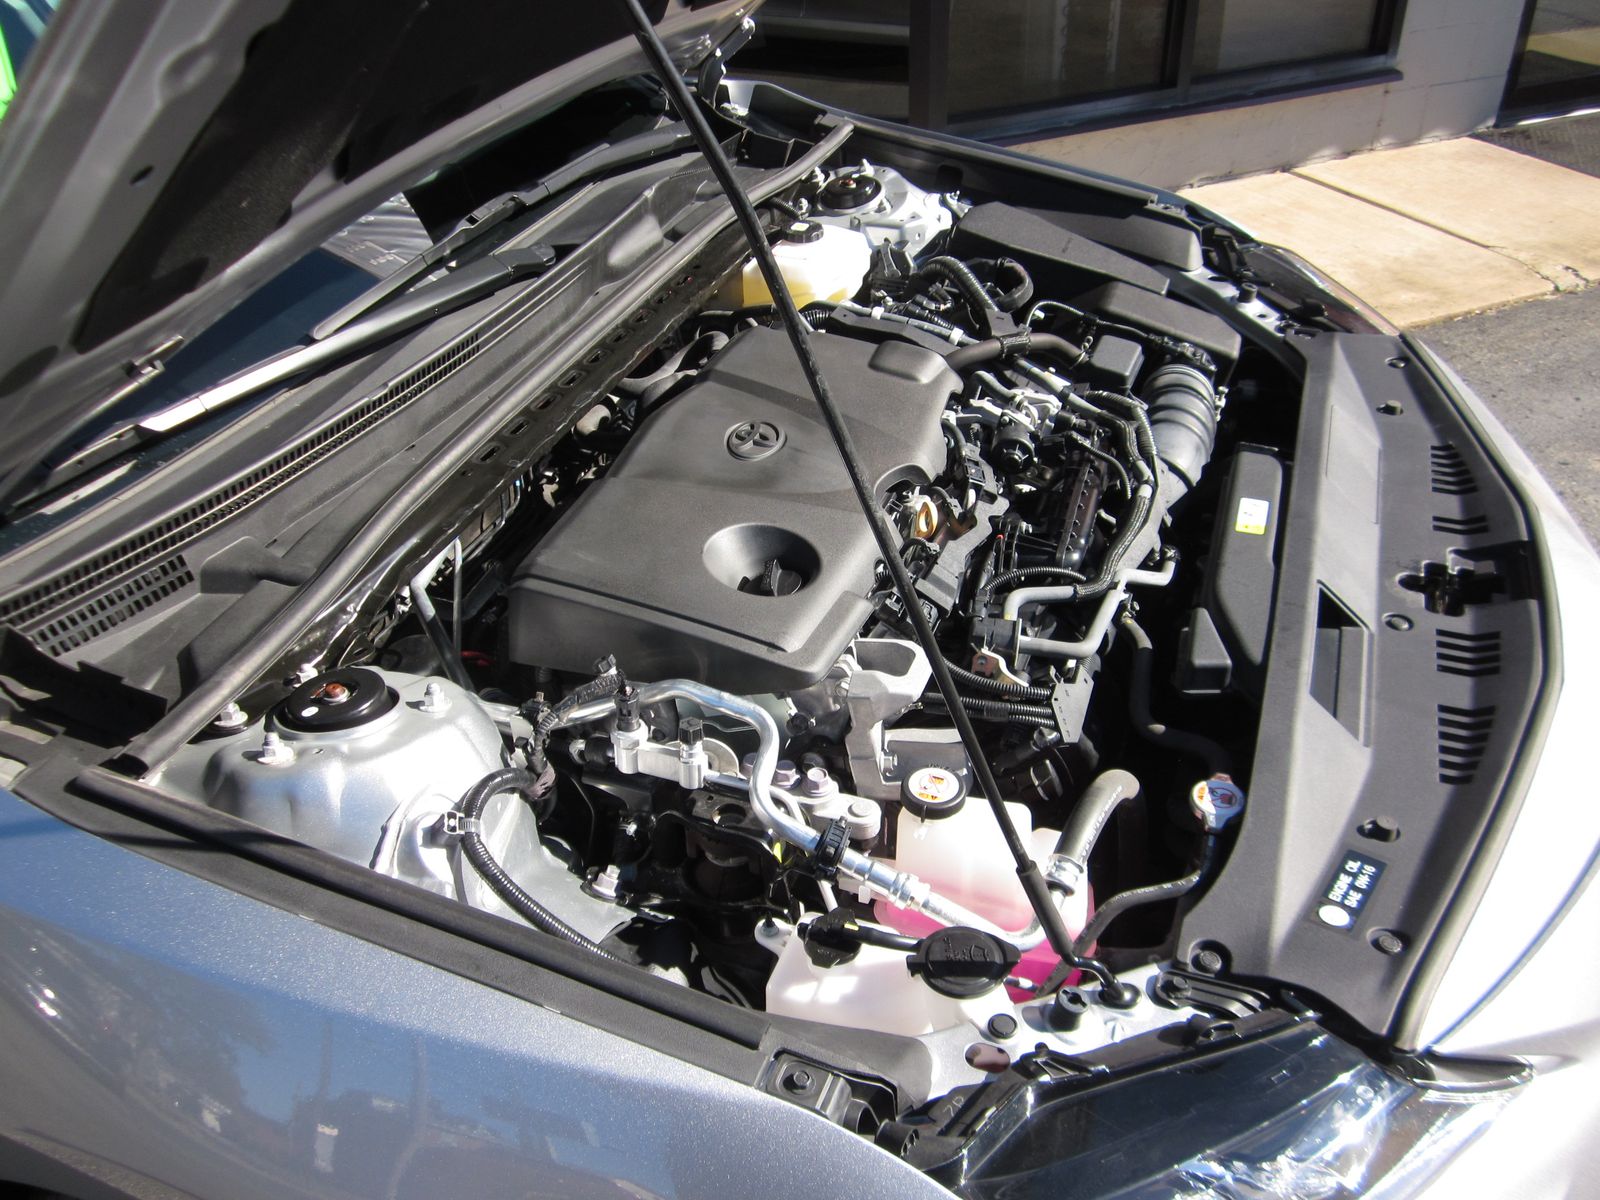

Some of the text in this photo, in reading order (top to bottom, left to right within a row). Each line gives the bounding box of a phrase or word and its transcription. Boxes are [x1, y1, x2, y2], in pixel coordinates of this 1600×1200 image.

[1327, 860, 1361, 903] ENGINE OIL
[1344, 889, 1363, 908] SAE
